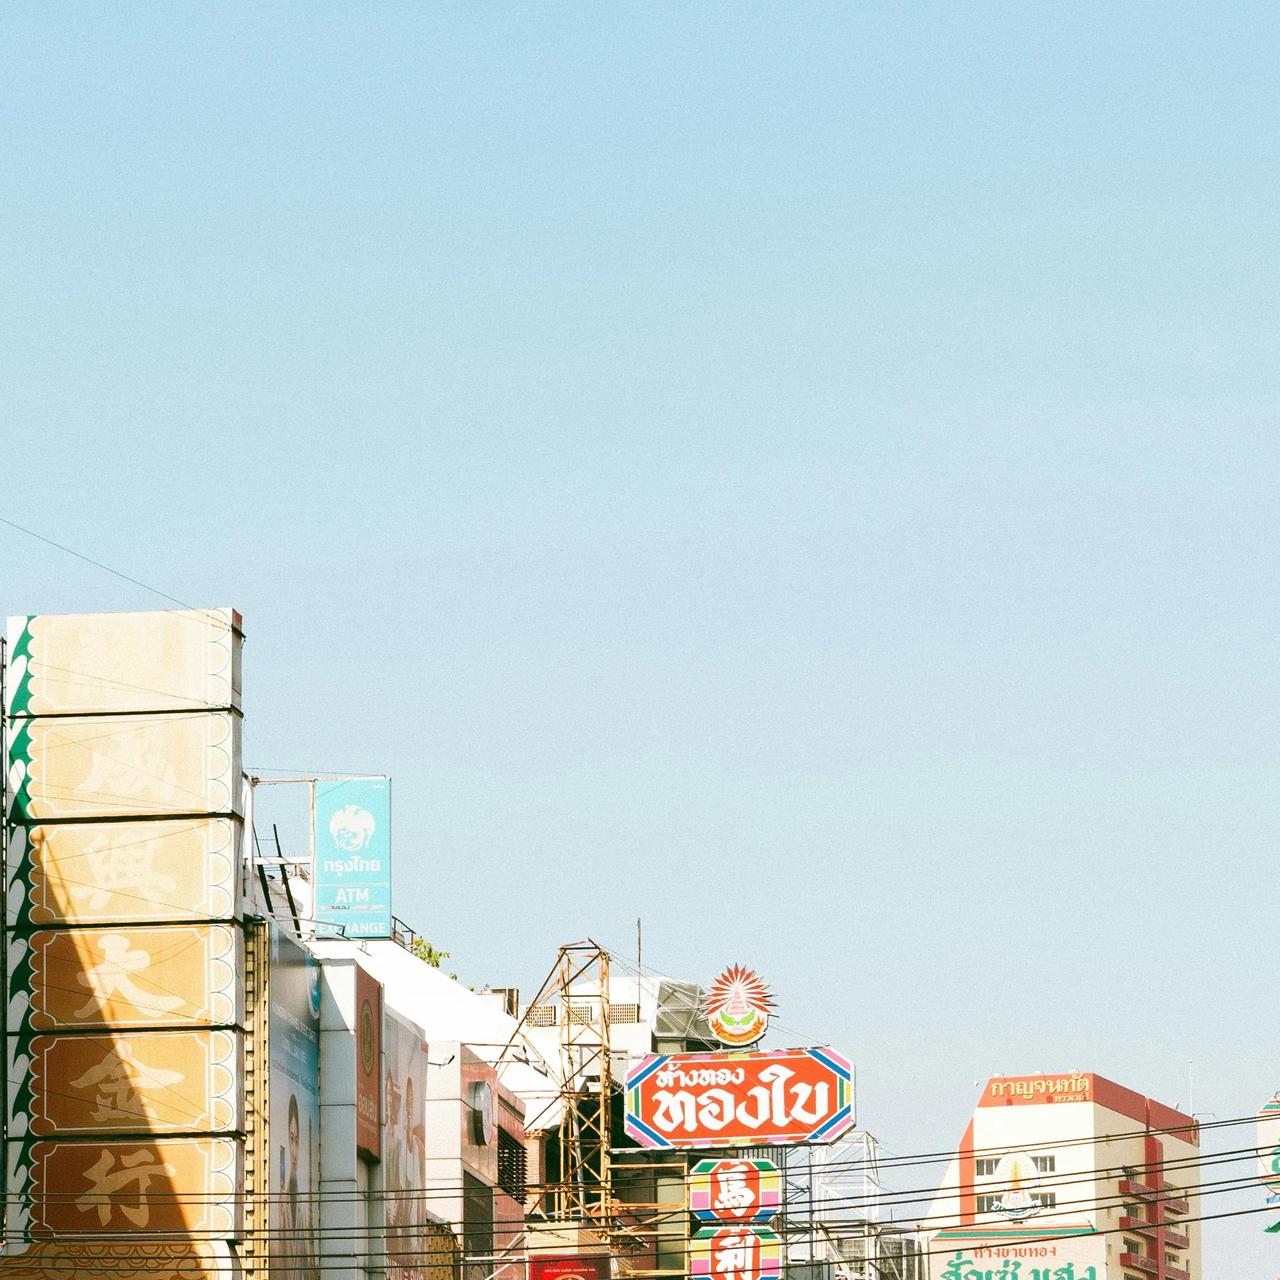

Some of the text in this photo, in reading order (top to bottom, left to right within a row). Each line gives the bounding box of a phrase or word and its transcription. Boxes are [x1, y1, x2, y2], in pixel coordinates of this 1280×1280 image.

[335, 887, 369, 903] ATM
[656, 1064, 745, 1088] ห้างทอง
[651, 1064, 830, 1133] ทองใบ
[973, 1243, 1057, 1258] ห้างขายทอง
